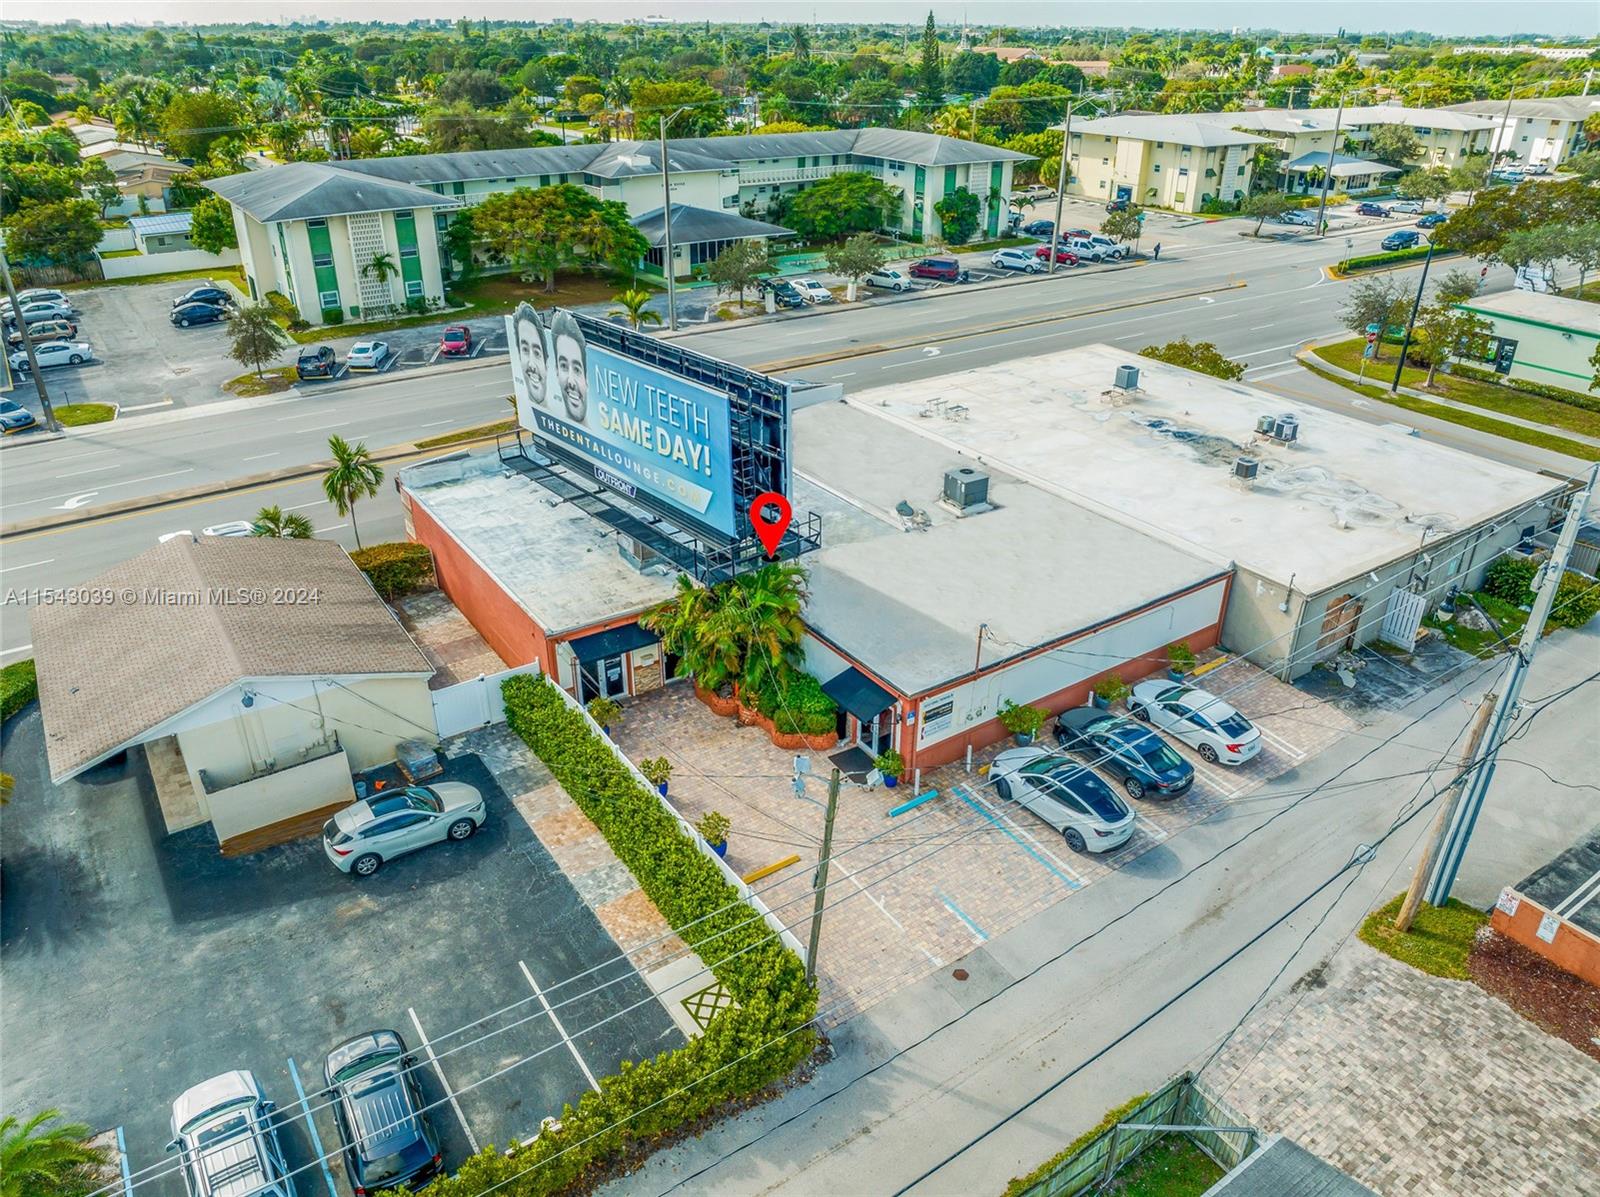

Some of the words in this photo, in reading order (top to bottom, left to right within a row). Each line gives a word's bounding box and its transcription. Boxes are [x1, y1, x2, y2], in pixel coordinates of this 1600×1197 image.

[595, 364, 638, 409] NEW
[644, 384, 709, 439] TEETH
[598, 401, 652, 450] SAME
[656, 426, 711, 476] DAY!
[597, 469, 634, 496] OUTFRONT
